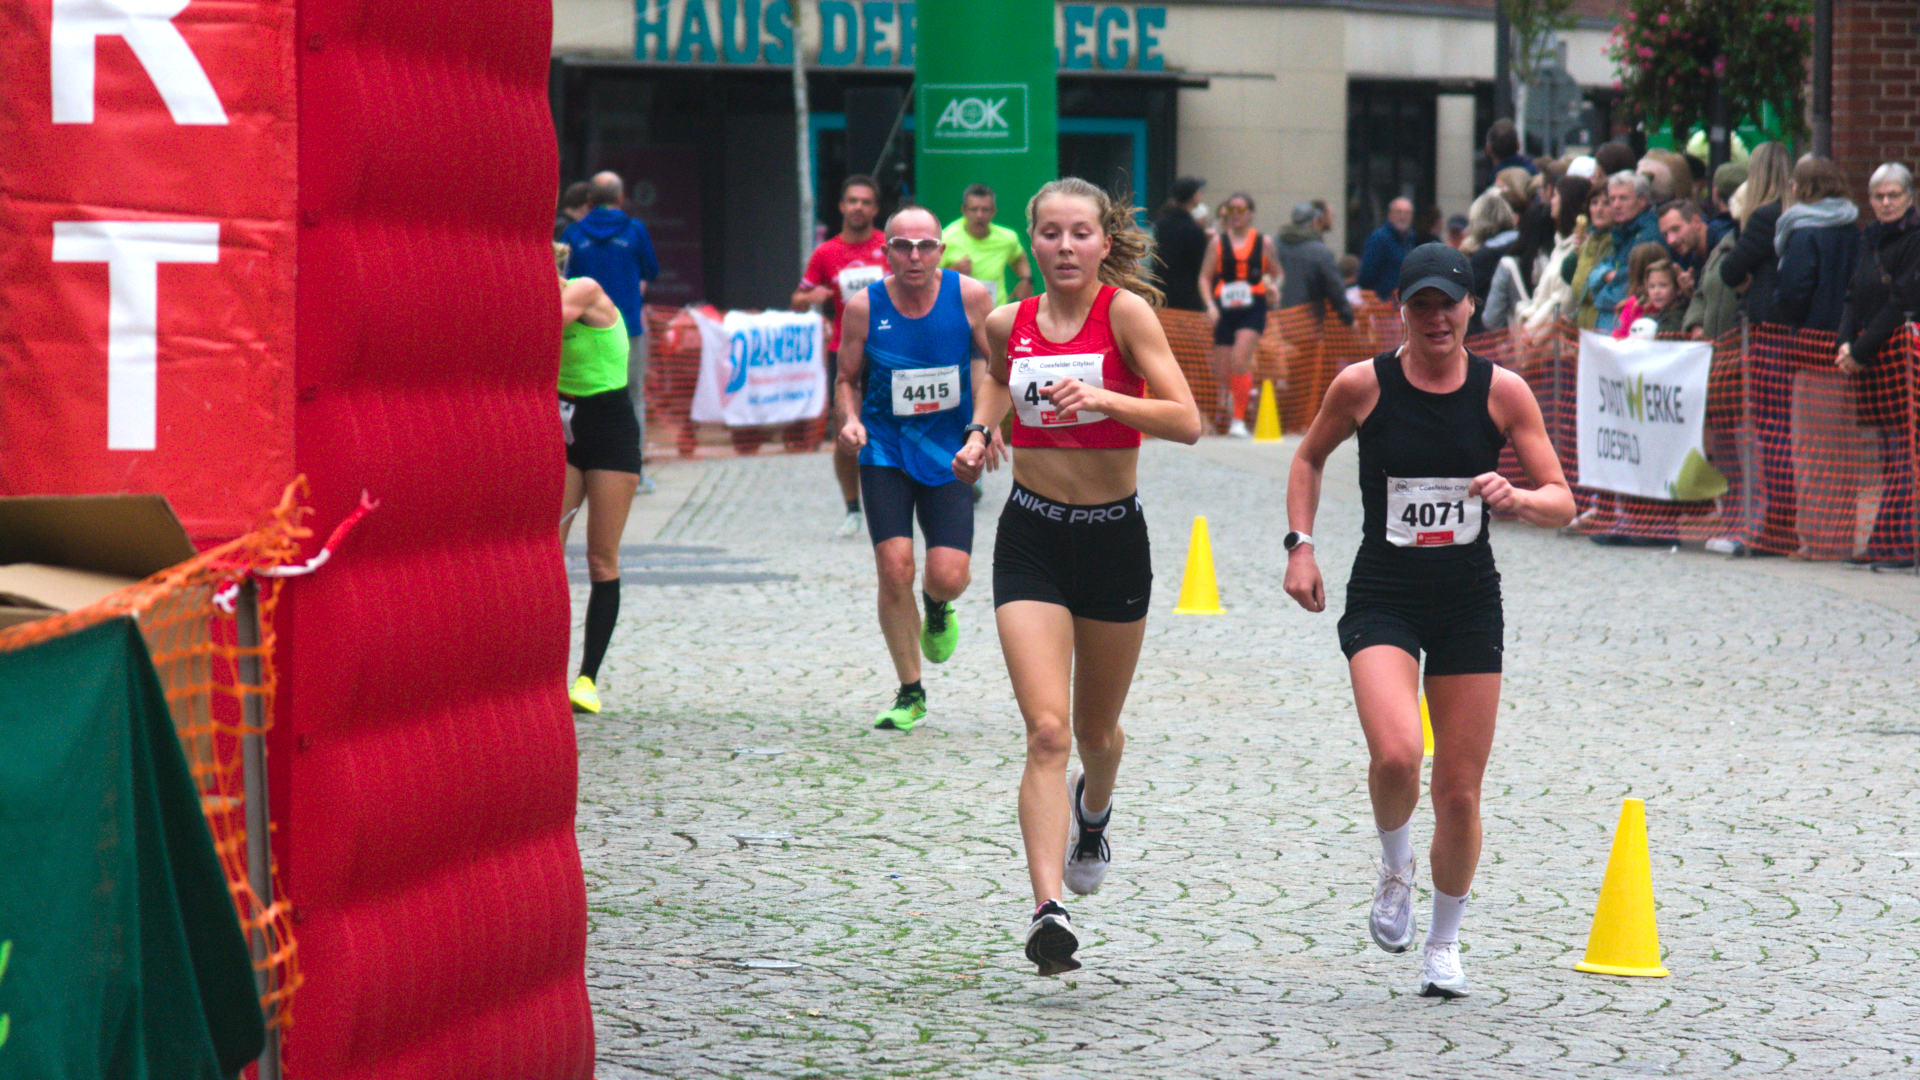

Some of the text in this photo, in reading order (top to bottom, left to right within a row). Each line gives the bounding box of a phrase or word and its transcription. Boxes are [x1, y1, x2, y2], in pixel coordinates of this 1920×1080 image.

[634, 0, 795, 63] HAUS
[1055, 5, 1167, 71] EGE
[935, 97, 1009, 130] AOK
[902, 382, 950, 401] 4415
[1024, 378, 1084, 407] 44
[1597, 427, 1640, 465] COESFLD
[1454, 484, 1470, 492] City
[1012, 488, 1065, 522] NIKE
[1068, 505, 1127, 524] PRO
[1401, 500, 1465, 527] 4071
